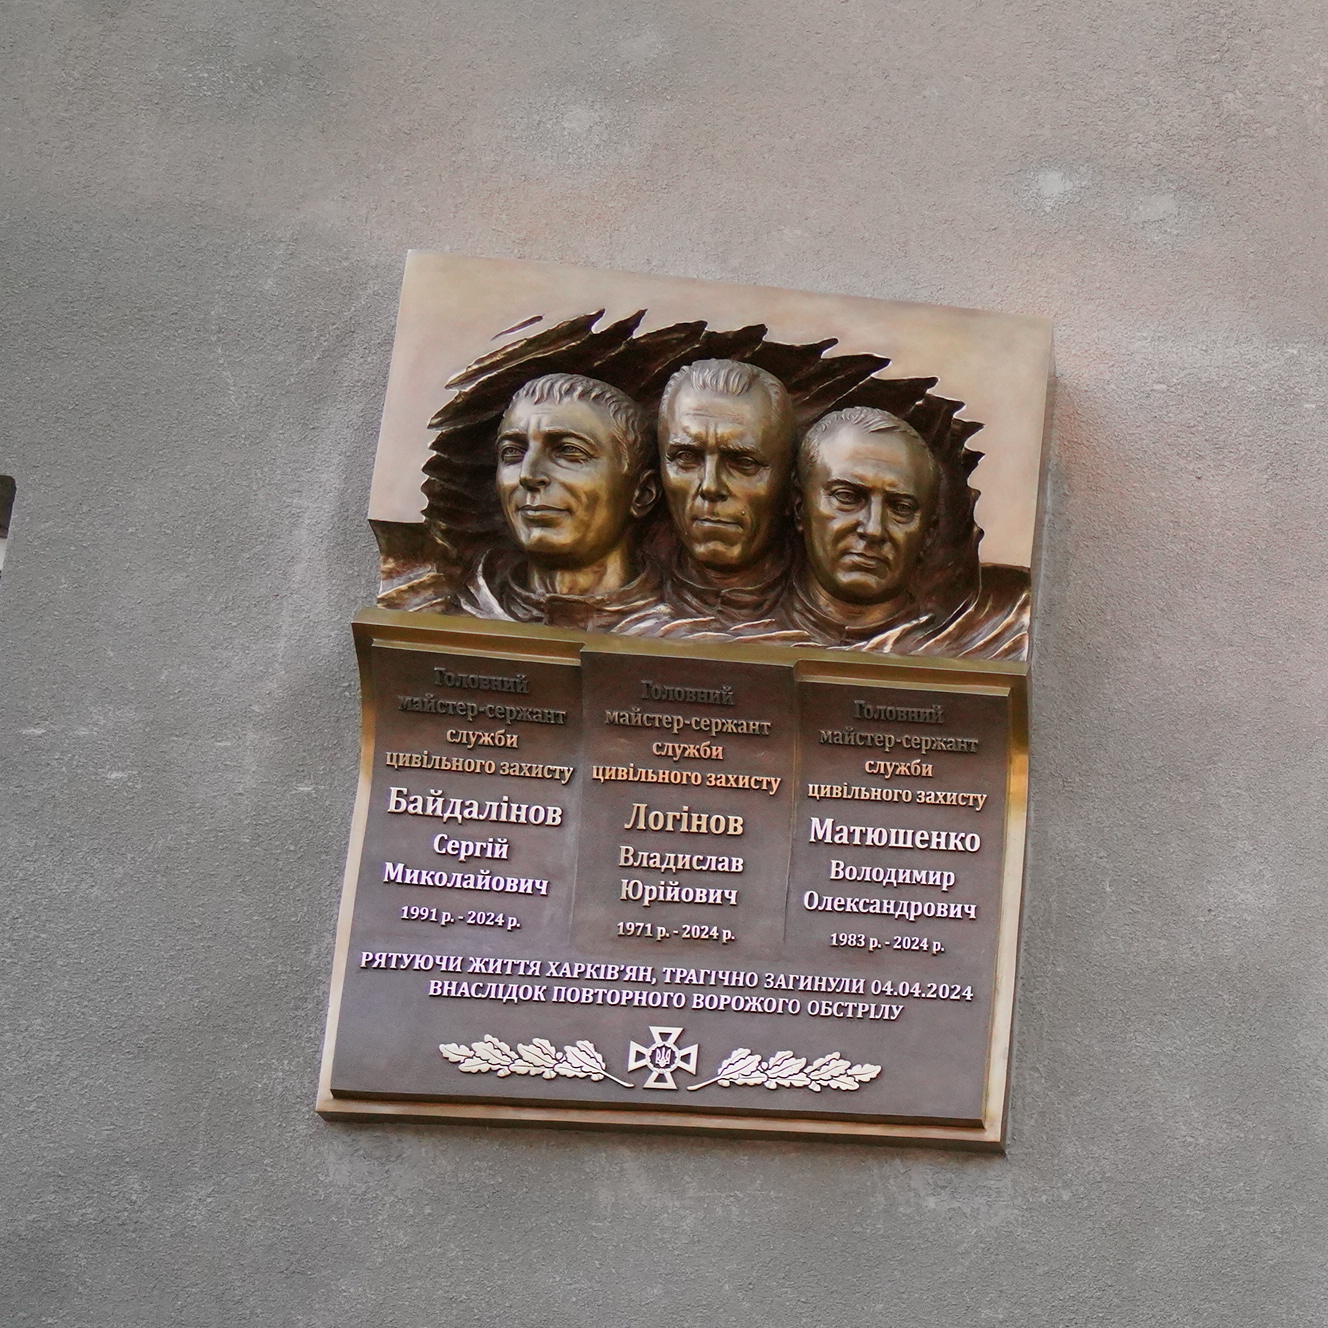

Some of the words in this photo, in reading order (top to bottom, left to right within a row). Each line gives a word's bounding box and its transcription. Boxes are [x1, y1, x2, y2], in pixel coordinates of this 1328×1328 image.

[433, 666, 530, 694] Головний
[640, 679, 735, 706] Головний
[397, 692, 568, 725] майстер-сержант
[604, 707, 772, 736] майстер-сержант
[854, 700, 944, 724] Головний
[446, 729, 519, 750] служби
[652, 741, 724, 761] служби
[819, 726, 979, 754] майстер-сержант
[385, 750, 496, 775] цивільного
[499, 759, 575, 785] захисту
[591, 763, 703, 787] цивільного
[706, 772, 782, 796] захисту
[864, 759, 934, 780] служби
[386, 786, 564, 828] Байдалінов
[807, 782, 913, 803] цивільного
[915, 789, 988, 812] захисту
[623, 803, 745, 836] Логінов
[432, 833, 511, 862] Сергій
[809, 816, 982, 853] Матюшенко
[618, 845, 745, 874] Владислав
[382, 861, 550, 897] Миколайович
[829, 859, 956, 892] Володимир
[619, 878, 739, 907] Юрійович
[802, 890, 978, 922] Олександрович
[400, 904, 438, 924] 1991
[440, 910, 456, 927] р.
[466, 909, 506, 927] 2024
[506, 915, 522, 931] р.
[616, 920, 654, 937] 1971
[656, 925, 671, 941] р.
[681, 923, 720, 940] 2024
[721, 928, 736, 944] р.
[829, 932, 866, 948] 1983
[868, 936, 882, 952] р.
[892, 935, 930, 951] 2024
[931, 940, 945, 956] р.
[359, 950, 464, 973] РЯТУЮЧИ
[467, 955, 542, 977] ЖИТТЯ
[545, 959, 658, 986] ХАРКІВ’ЯН,
[662, 965, 760, 989] ТРАГІЧНО
[763, 971, 867, 996] ЗАГИНУЛИ
[870, 978, 975, 1002] 04.04.2024
[428, 979, 548, 1004] ВНАСЛІДОК
[552, 985, 687, 1010] ПОВТОРНОГО
[691, 992, 802, 1016] ВОРОЖОГО
[807, 998, 906, 1022] ОБСТРІЛУ
